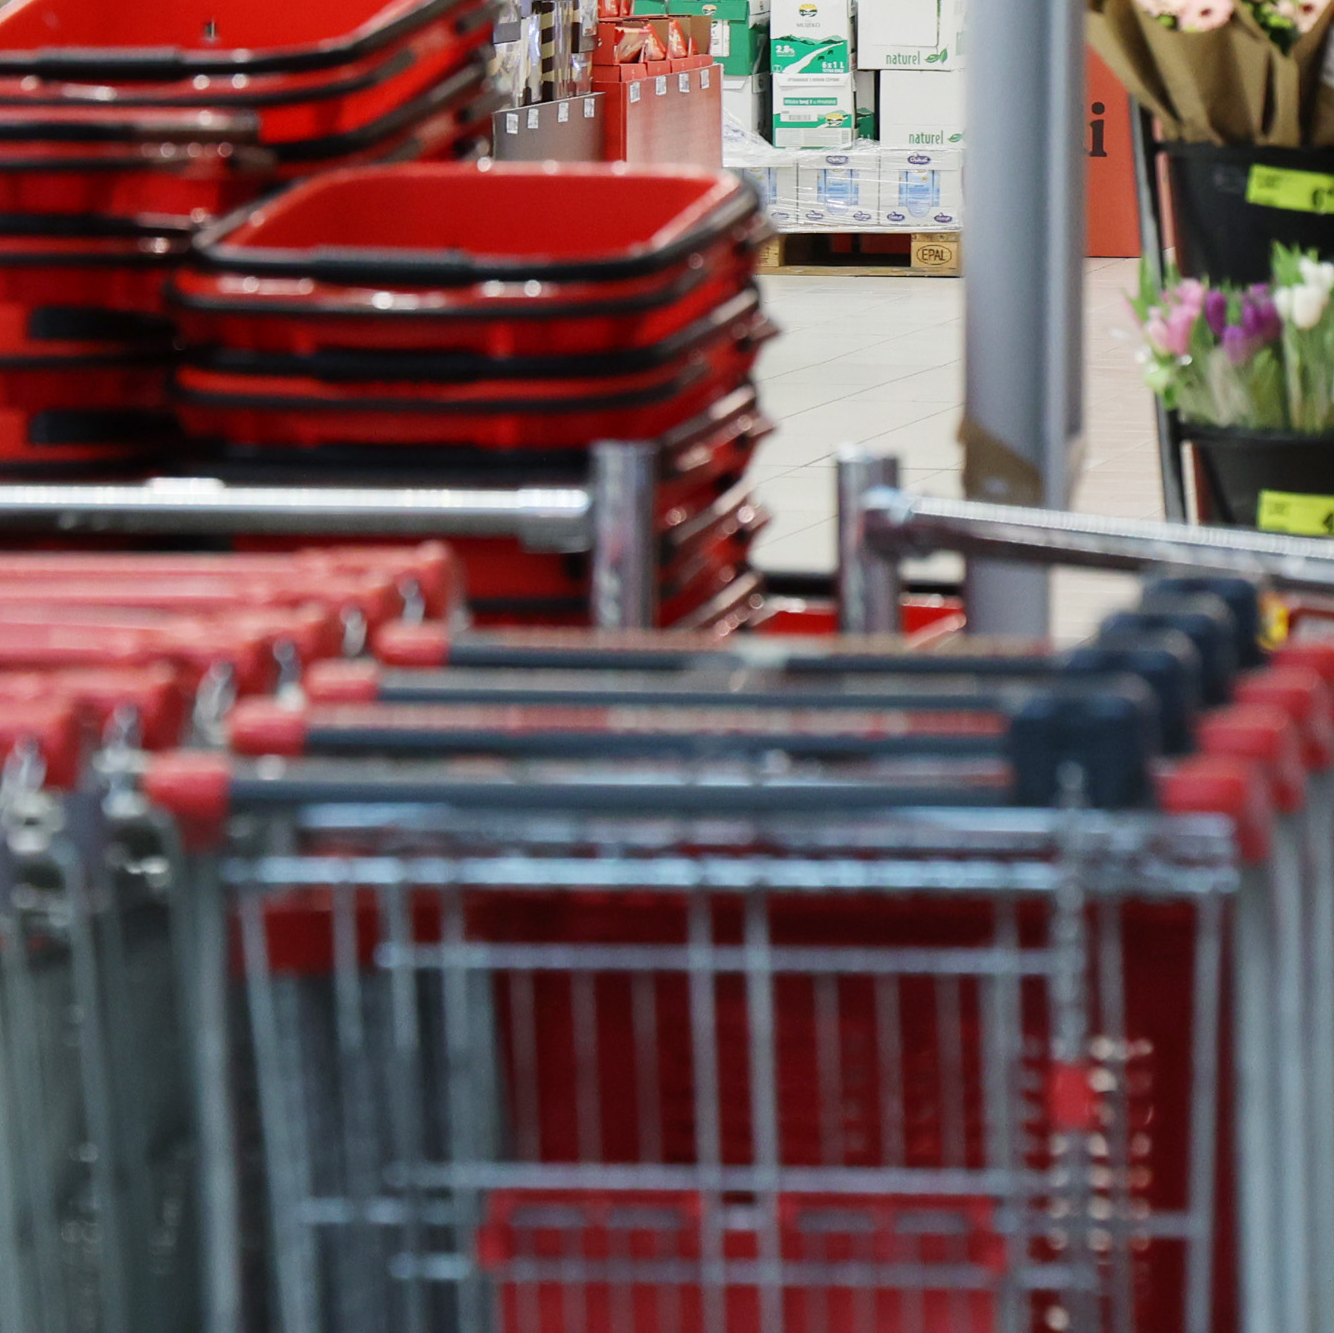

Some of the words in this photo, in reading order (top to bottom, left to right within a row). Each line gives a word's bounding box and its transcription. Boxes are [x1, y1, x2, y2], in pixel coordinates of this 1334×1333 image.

[886, 51, 921, 66] naturel
[908, 130, 944, 145] naturel
[921, 247, 947, 262] EPAL
